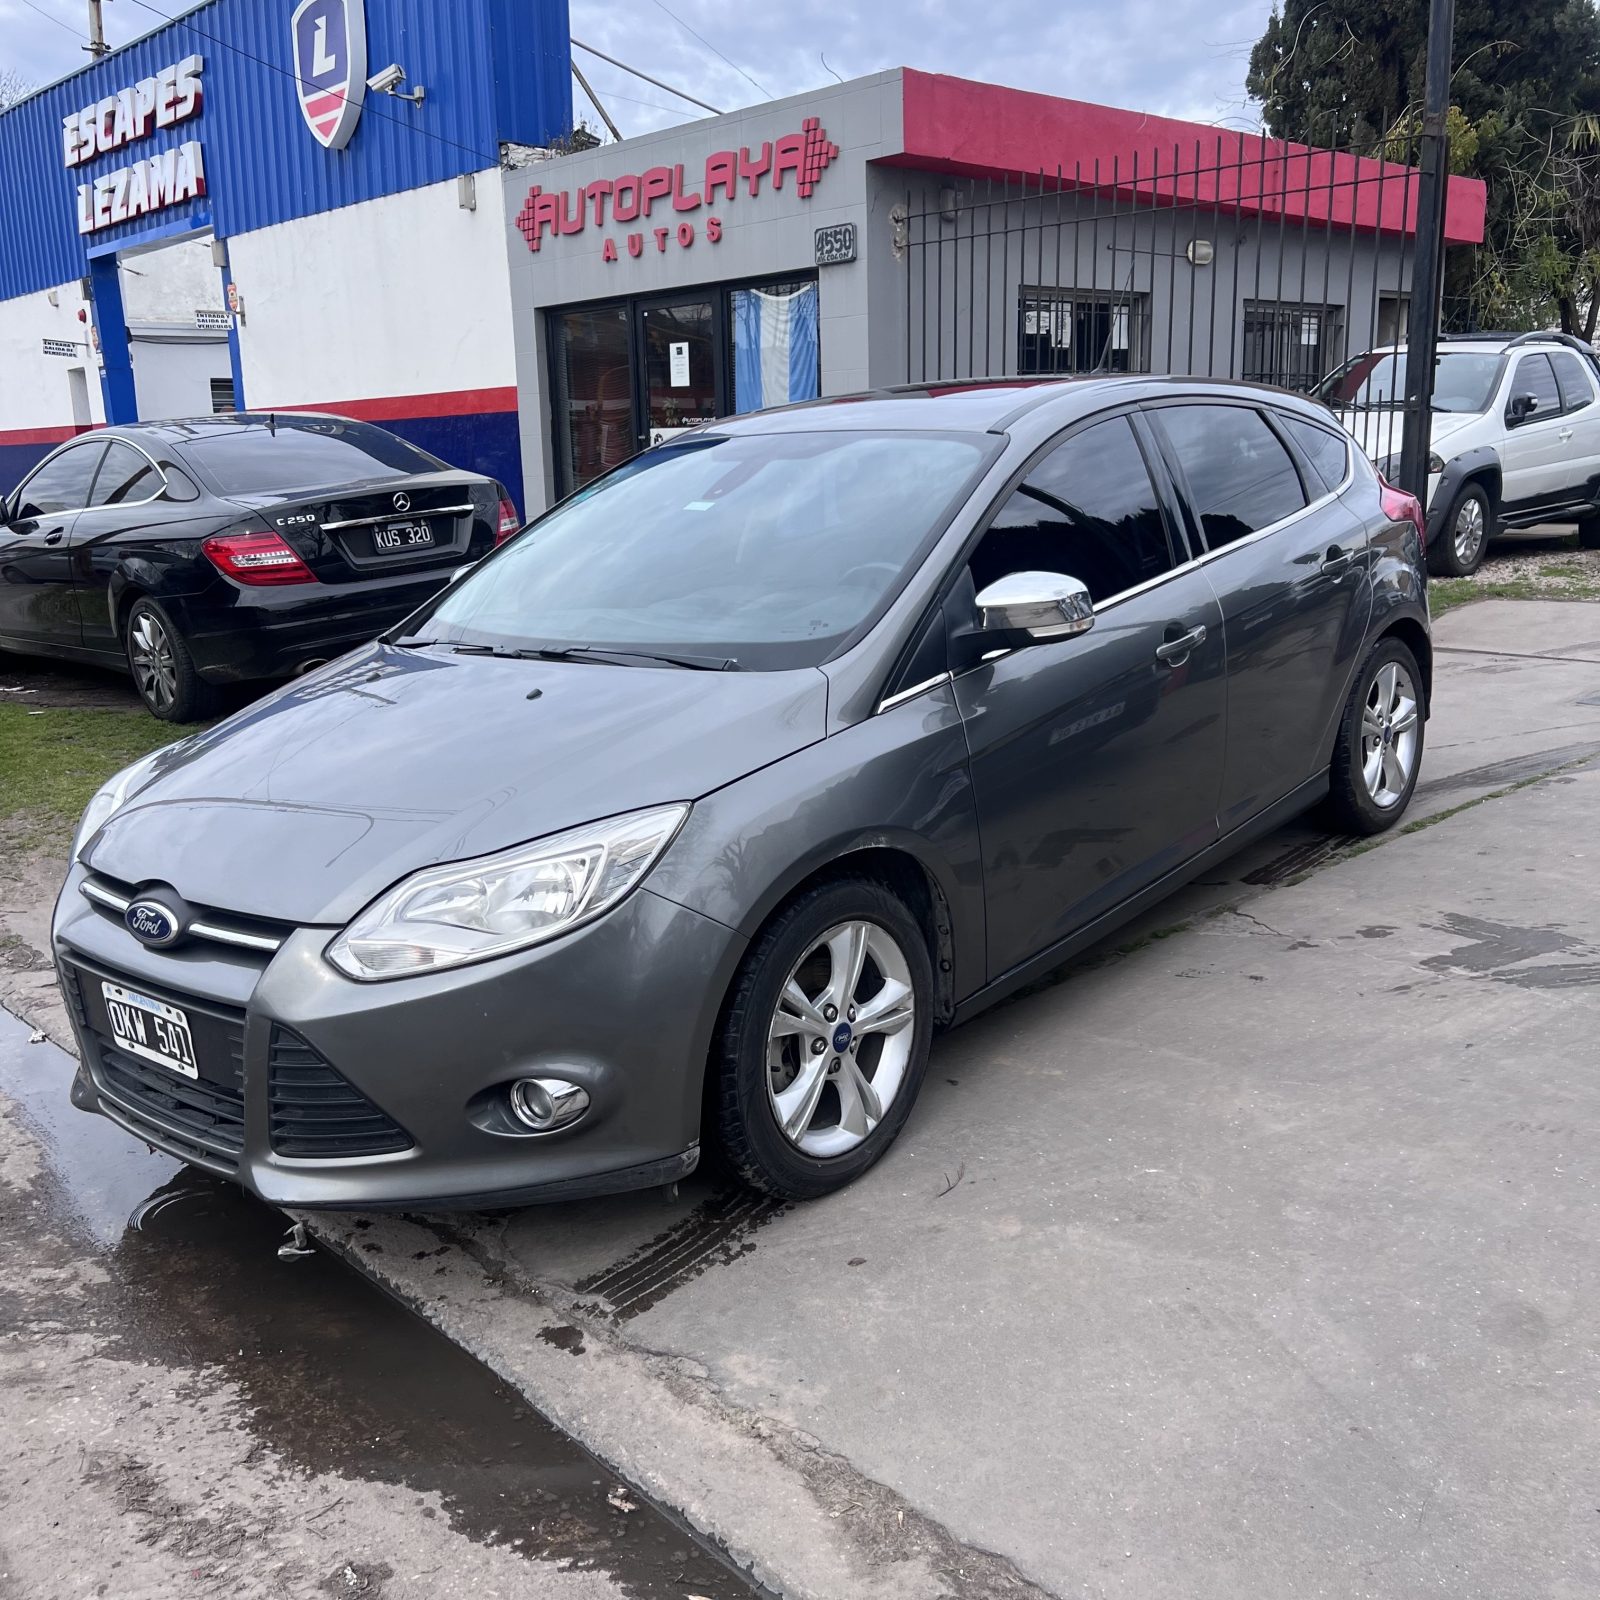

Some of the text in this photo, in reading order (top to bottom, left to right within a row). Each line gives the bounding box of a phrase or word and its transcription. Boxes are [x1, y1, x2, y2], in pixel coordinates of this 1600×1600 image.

[63, 54, 203, 168] ESCAPES
[78, 141, 206, 234] LEZAMA
[533, 132, 810, 237] AUTOPLAYA
[602, 217, 722, 262] AUTOS
[816, 228, 852, 256] 4550
[276, 514, 316, 526] C 250
[375, 526, 430, 548] KUS 320
[132, 907, 161, 936] Ford
[109, 1001, 192, 1064] OKW 541
